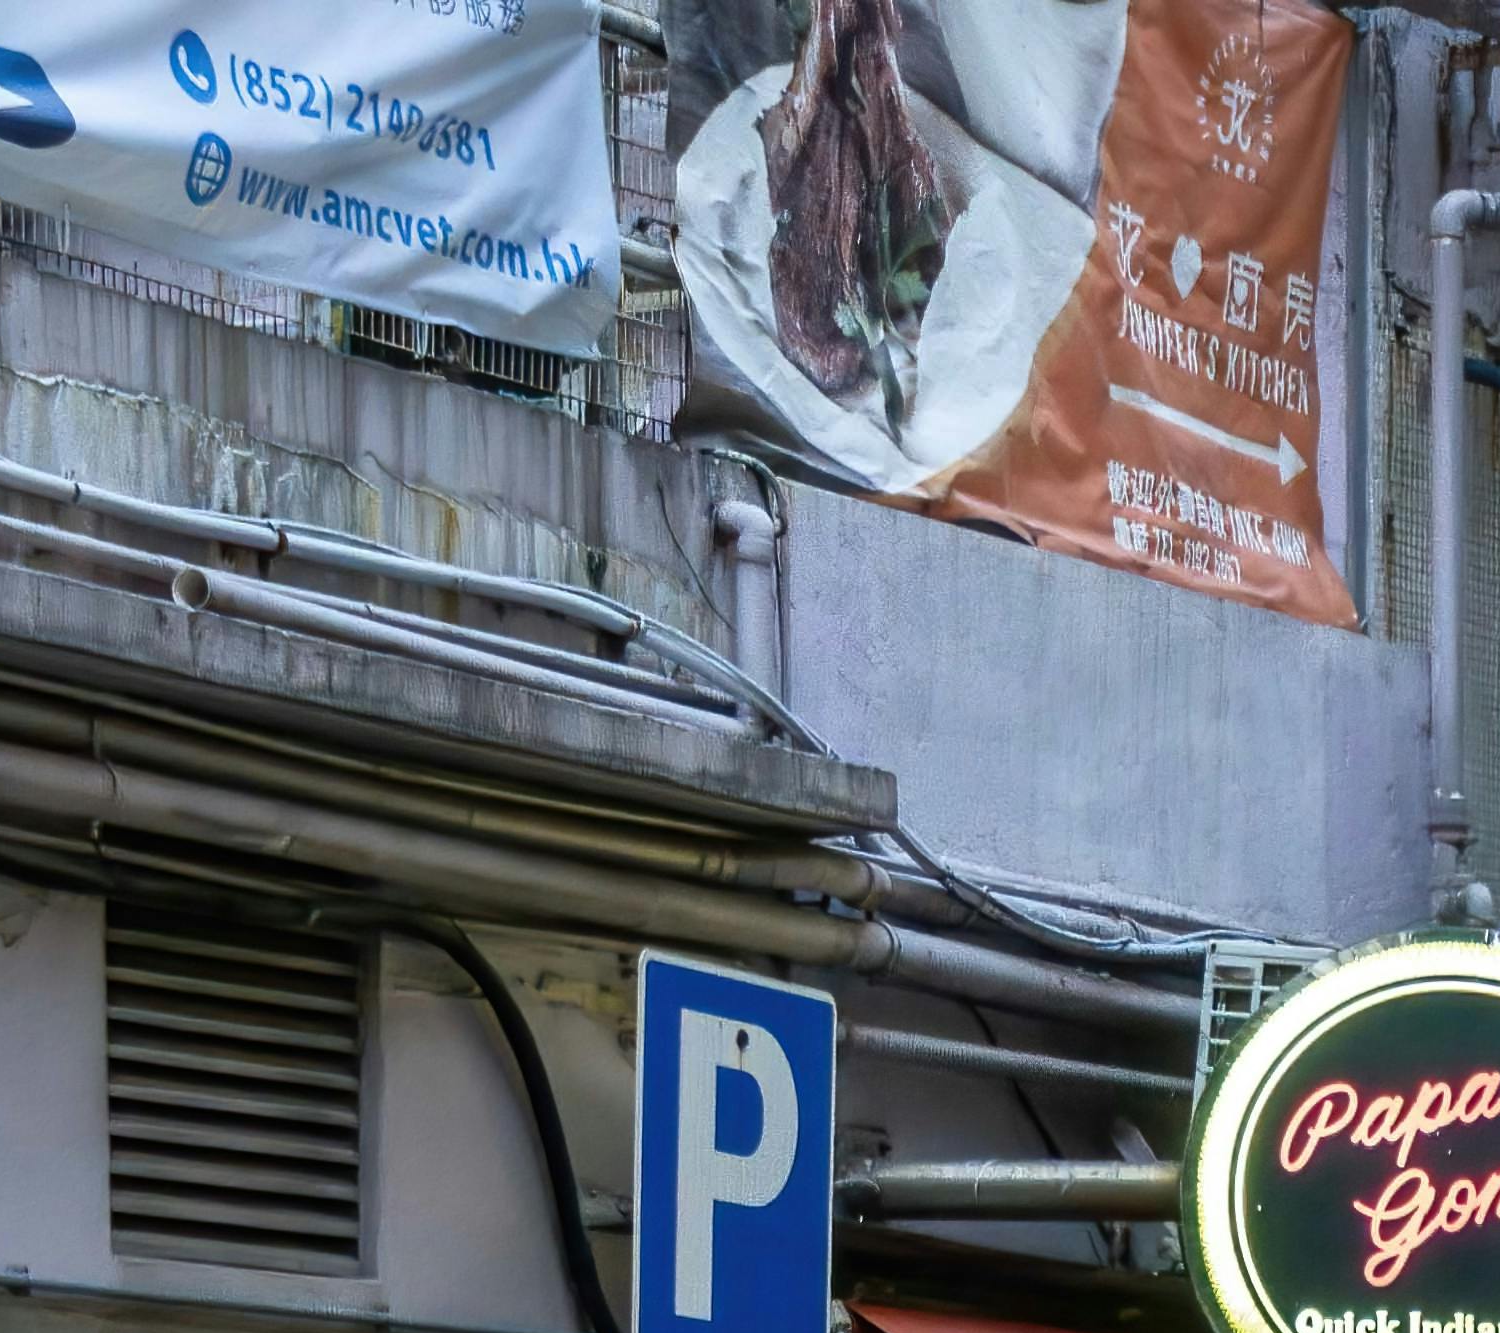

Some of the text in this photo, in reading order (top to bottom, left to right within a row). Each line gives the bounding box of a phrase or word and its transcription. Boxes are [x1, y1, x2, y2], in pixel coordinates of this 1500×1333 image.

[230, 54, 332, 131] (852)
[237, 168, 595, 290] www.amcvet.com.hk
[1225, 343, 1309, 416] KITCHEN
[673, 1008, 799, 1321] P
